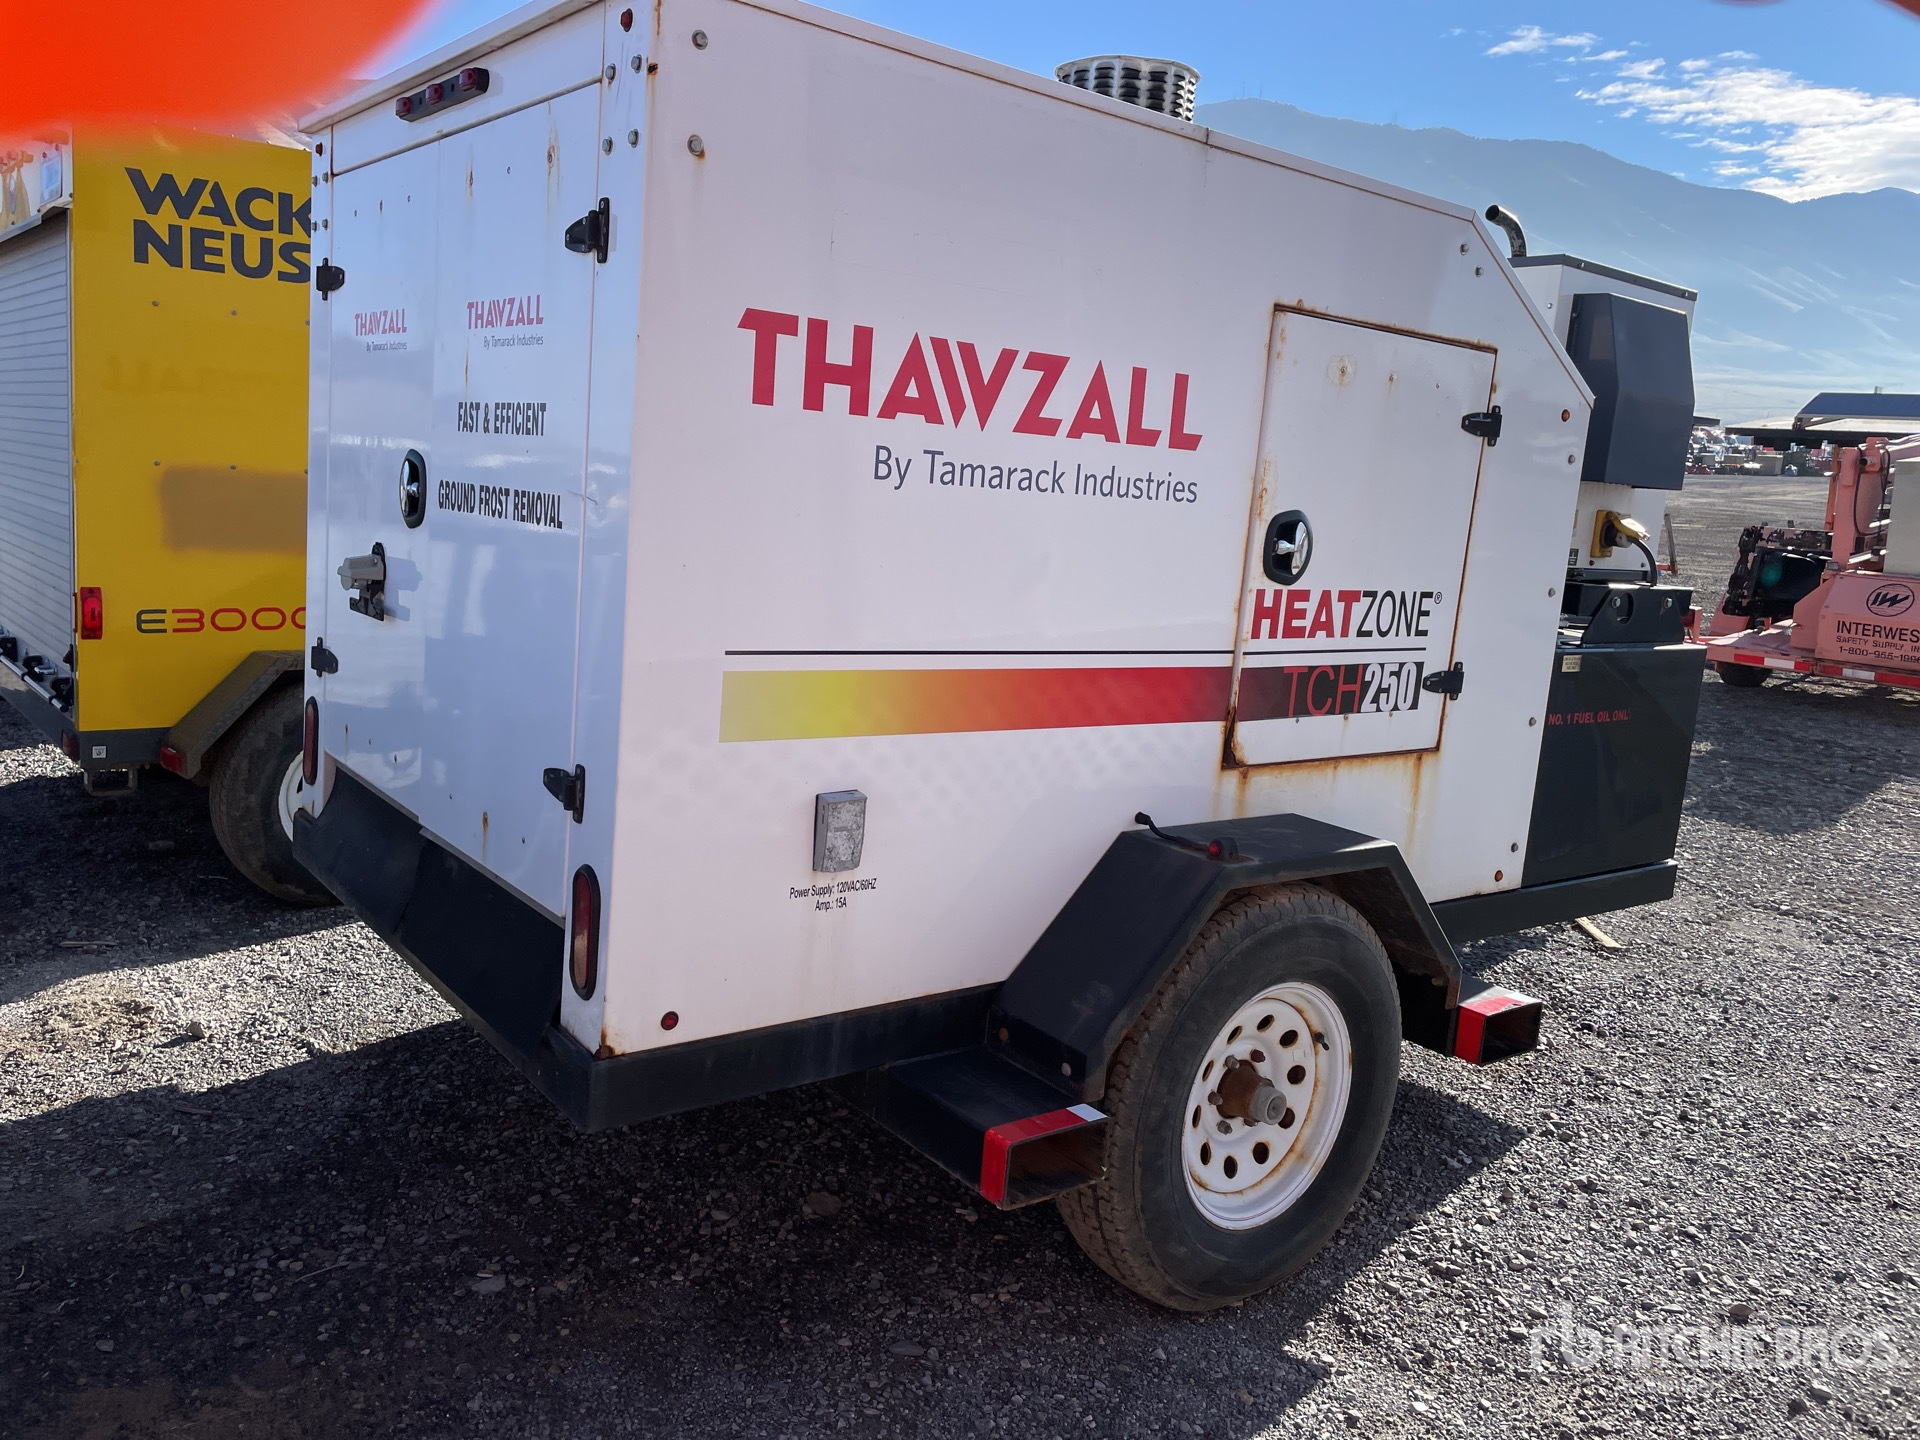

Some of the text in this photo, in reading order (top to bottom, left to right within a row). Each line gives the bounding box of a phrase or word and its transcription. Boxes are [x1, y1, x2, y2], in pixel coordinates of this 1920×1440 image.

[354, 308, 407, 336] THAWZALL
[467, 295, 544, 329] THAWZALL
[491, 334, 515, 347] Tamarack
[517, 332, 544, 346] Industries
[737, 307, 1203, 451] THAWZALL
[457, 402, 547, 436] FAST & EFFICIENT
[873, 445, 1198, 504] By Tamarack Industries
[438, 479, 563, 529] GROUND FROST REMOVAL
[1836, 635, 1869, 645] SAFETY
[1283, 661, 1418, 717] TCH250
[1548, 713, 1563, 726] NO.
[1566, 713, 1571, 725] 1
[1573, 712, 1595, 724] FUEL
[1597, 710, 1610, 723] OIL
[789, 878, 877, 899] Power Supply: 120VAC/60HZ
[835, 897, 847, 908] 15A
